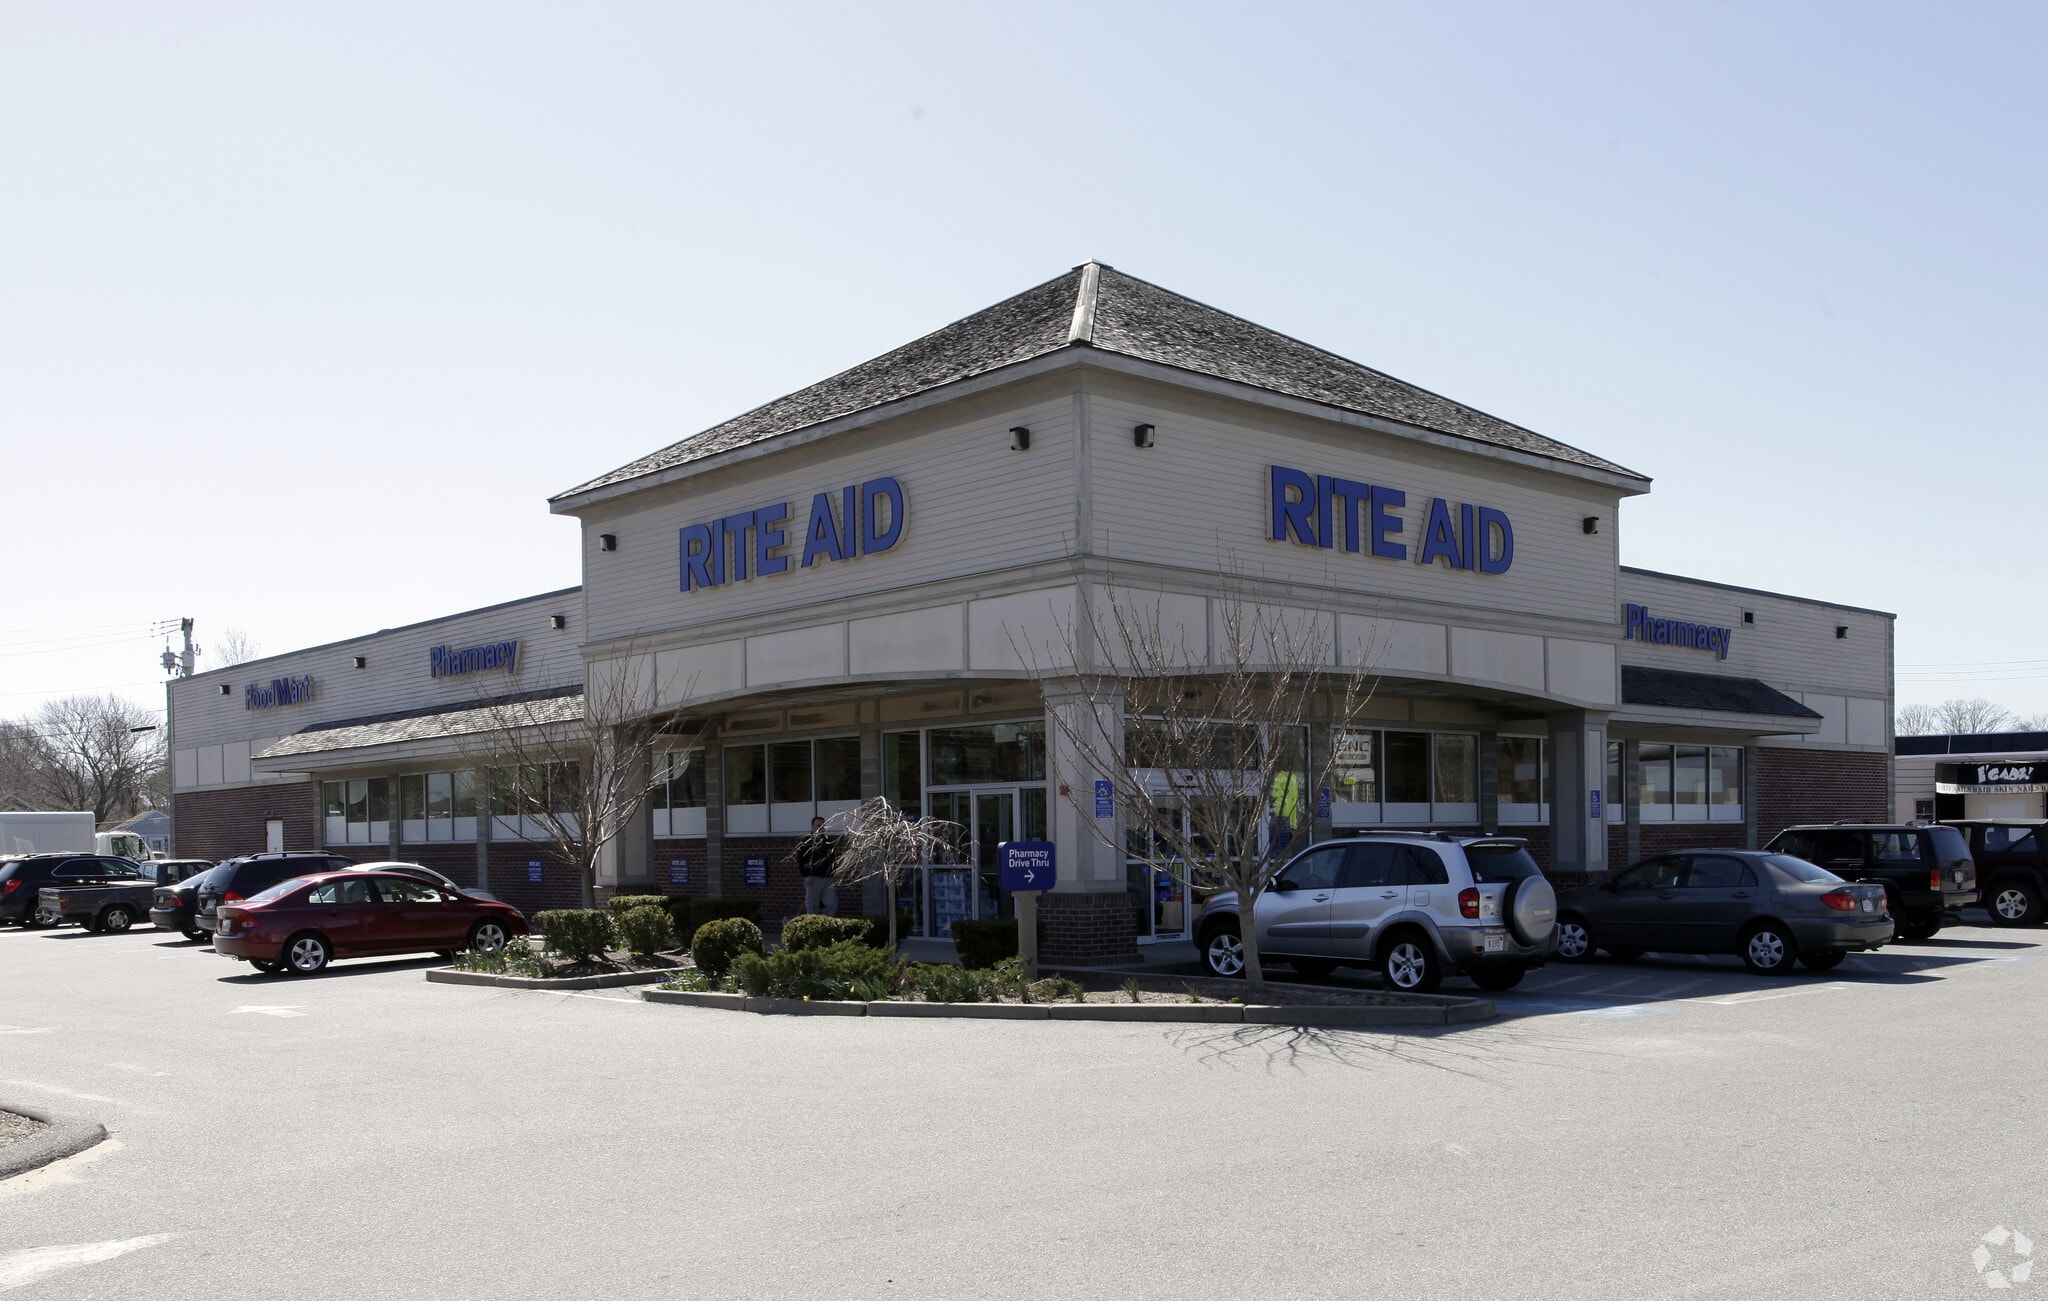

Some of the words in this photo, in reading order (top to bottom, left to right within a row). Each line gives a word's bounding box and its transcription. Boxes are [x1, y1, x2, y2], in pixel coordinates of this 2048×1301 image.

[679, 502, 789, 592] RITE
[800, 476, 905, 569] AID
[1270, 465, 1407, 560] RITE
[1421, 497, 1514, 575] AID
[1626, 603, 1732, 661] Pharmacy
[429, 640, 519, 678] Pharmacy
[245, 680, 276, 711] Food
[276, 675, 311, 706] Mart
[1008, 859, 1030, 868] Drive
[1031, 858, 1050, 867] Thru
[1009, 849, 1049, 860] Pharmacy
